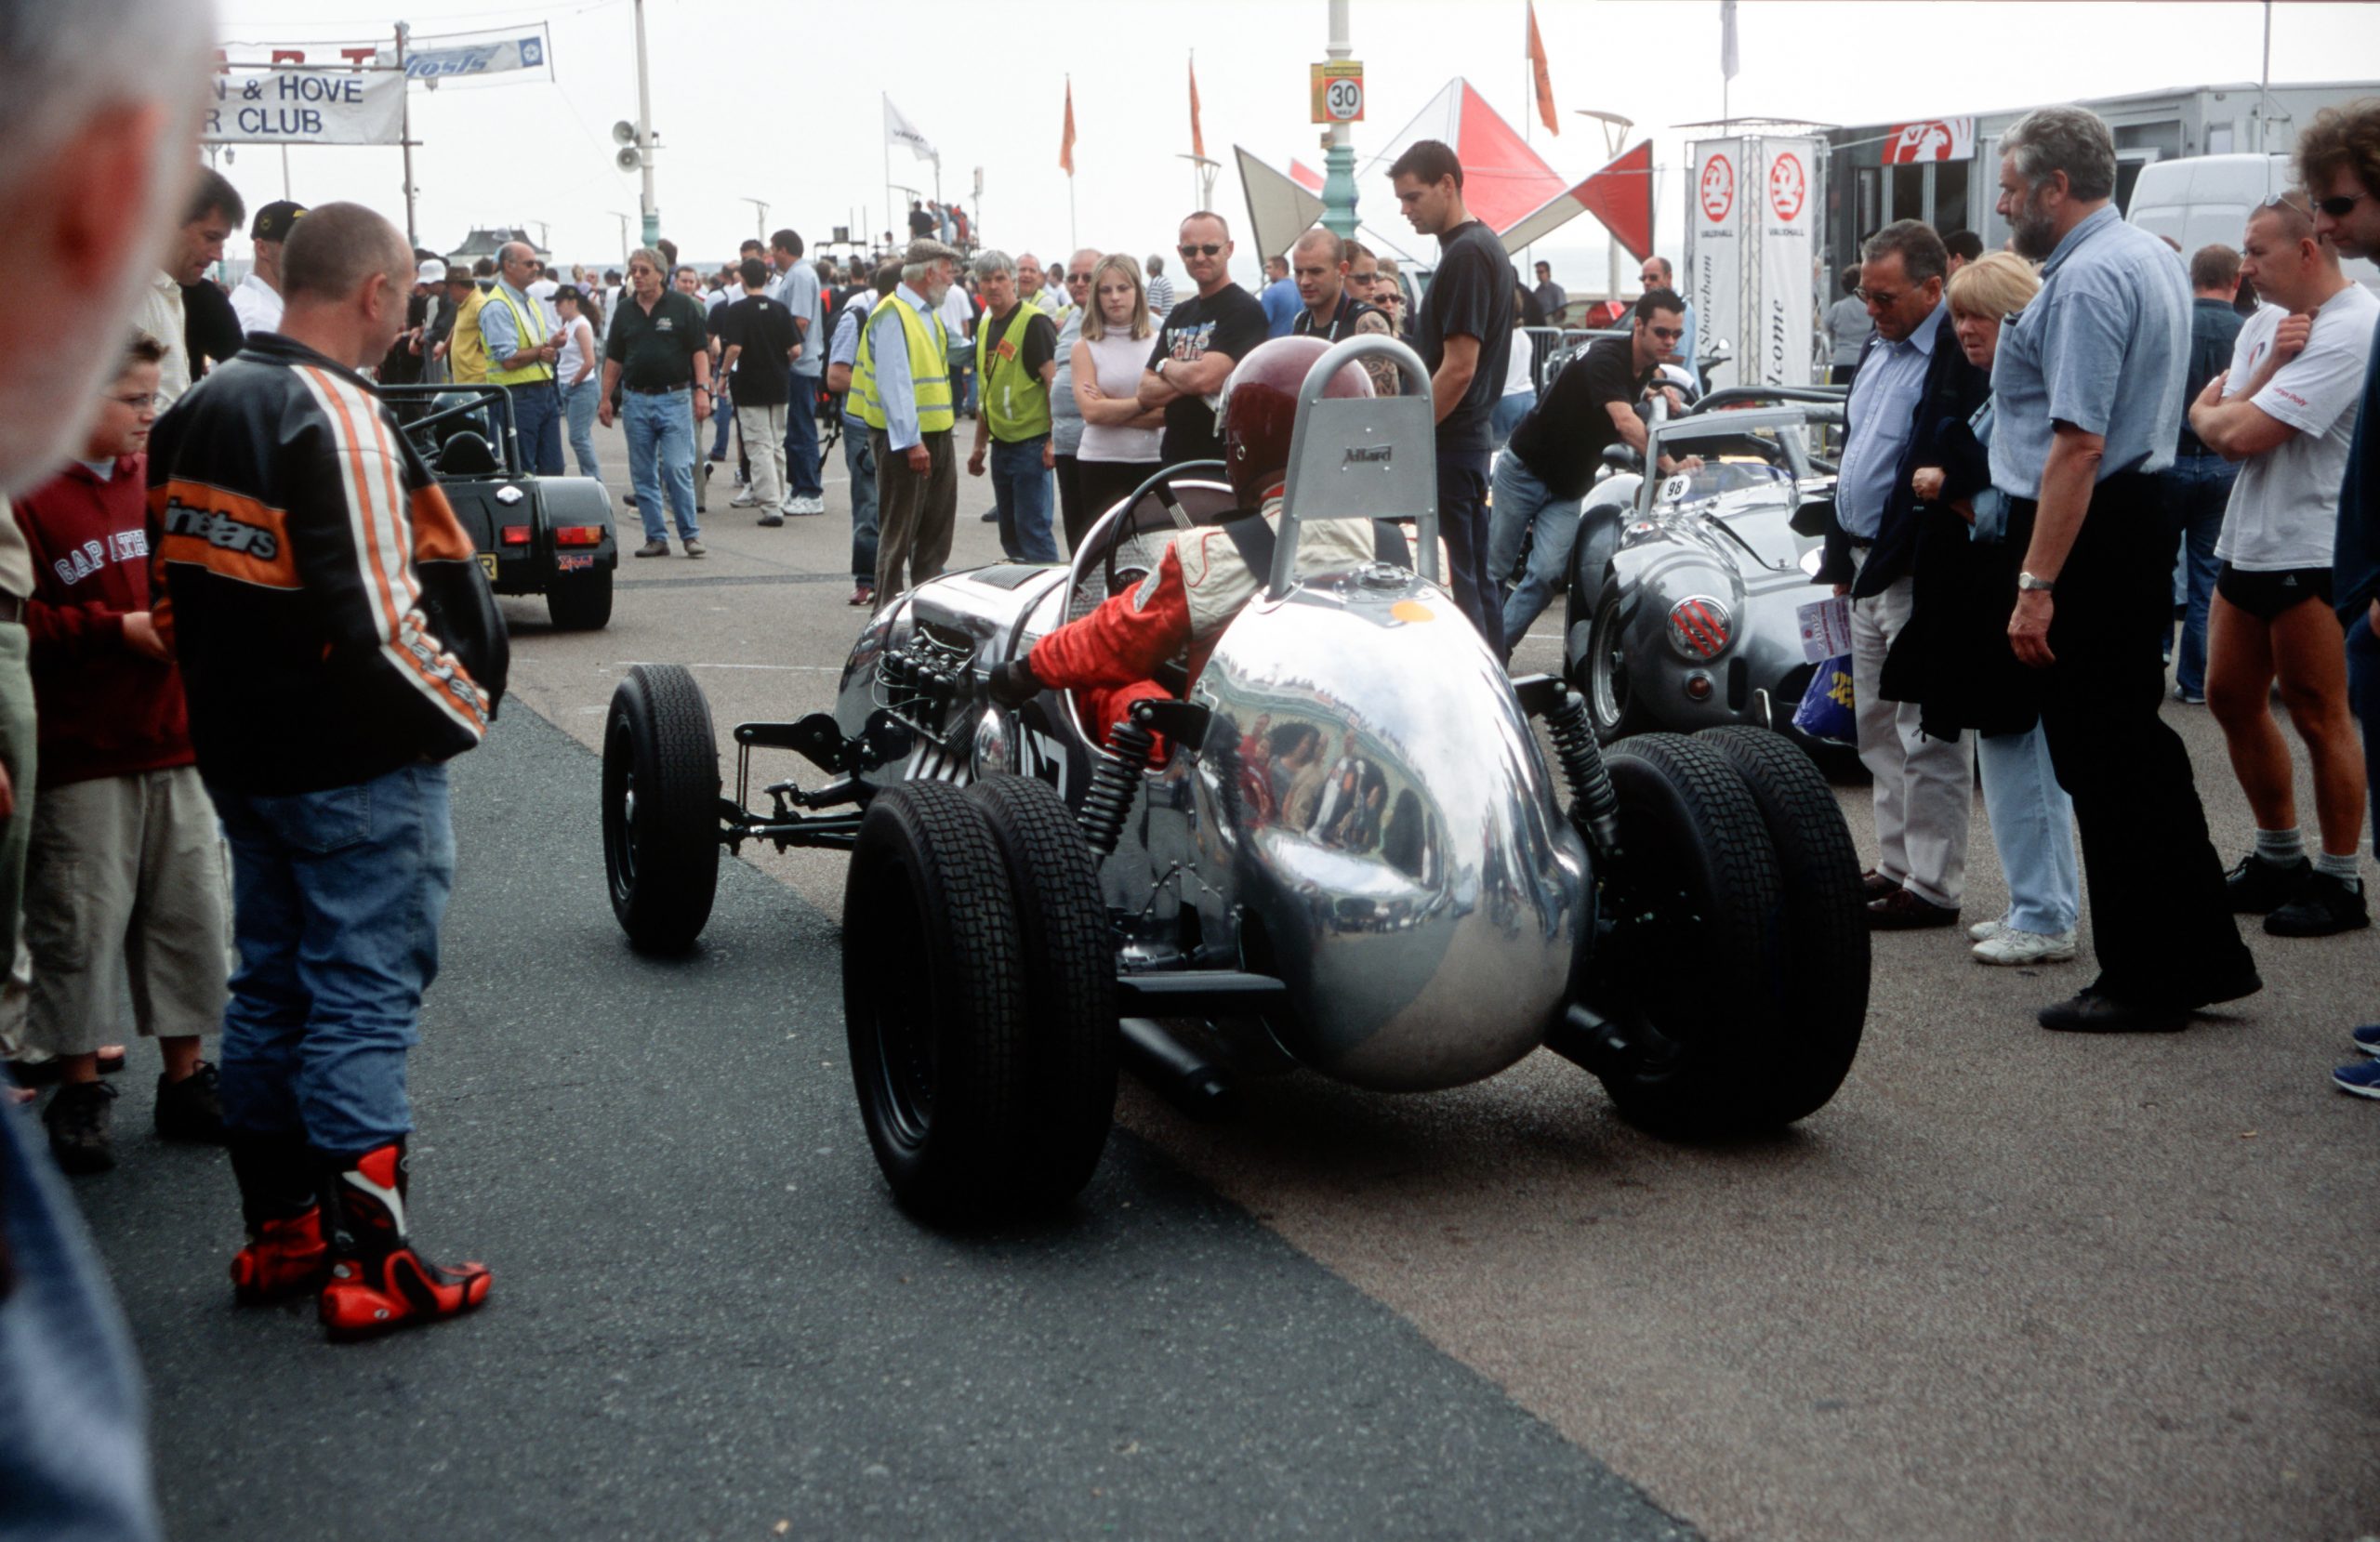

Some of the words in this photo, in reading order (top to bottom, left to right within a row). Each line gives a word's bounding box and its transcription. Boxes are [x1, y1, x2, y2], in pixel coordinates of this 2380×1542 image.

[243, 79, 262, 100] &
[279, 75, 364, 104] HOVE
[1332, 85, 1357, 108] 30
[238, 107, 323, 135] CLUB
[1700, 229, 1734, 239] VAUXHALL
[1768, 227, 1805, 238] VAUXHALL
[1699, 255, 1712, 348] Shoreham
[1766, 299, 1784, 388] lcome
[1342, 444, 1392, 467] Allard
[1667, 480, 1684, 496] 98
[55, 539, 104, 586] GAP
